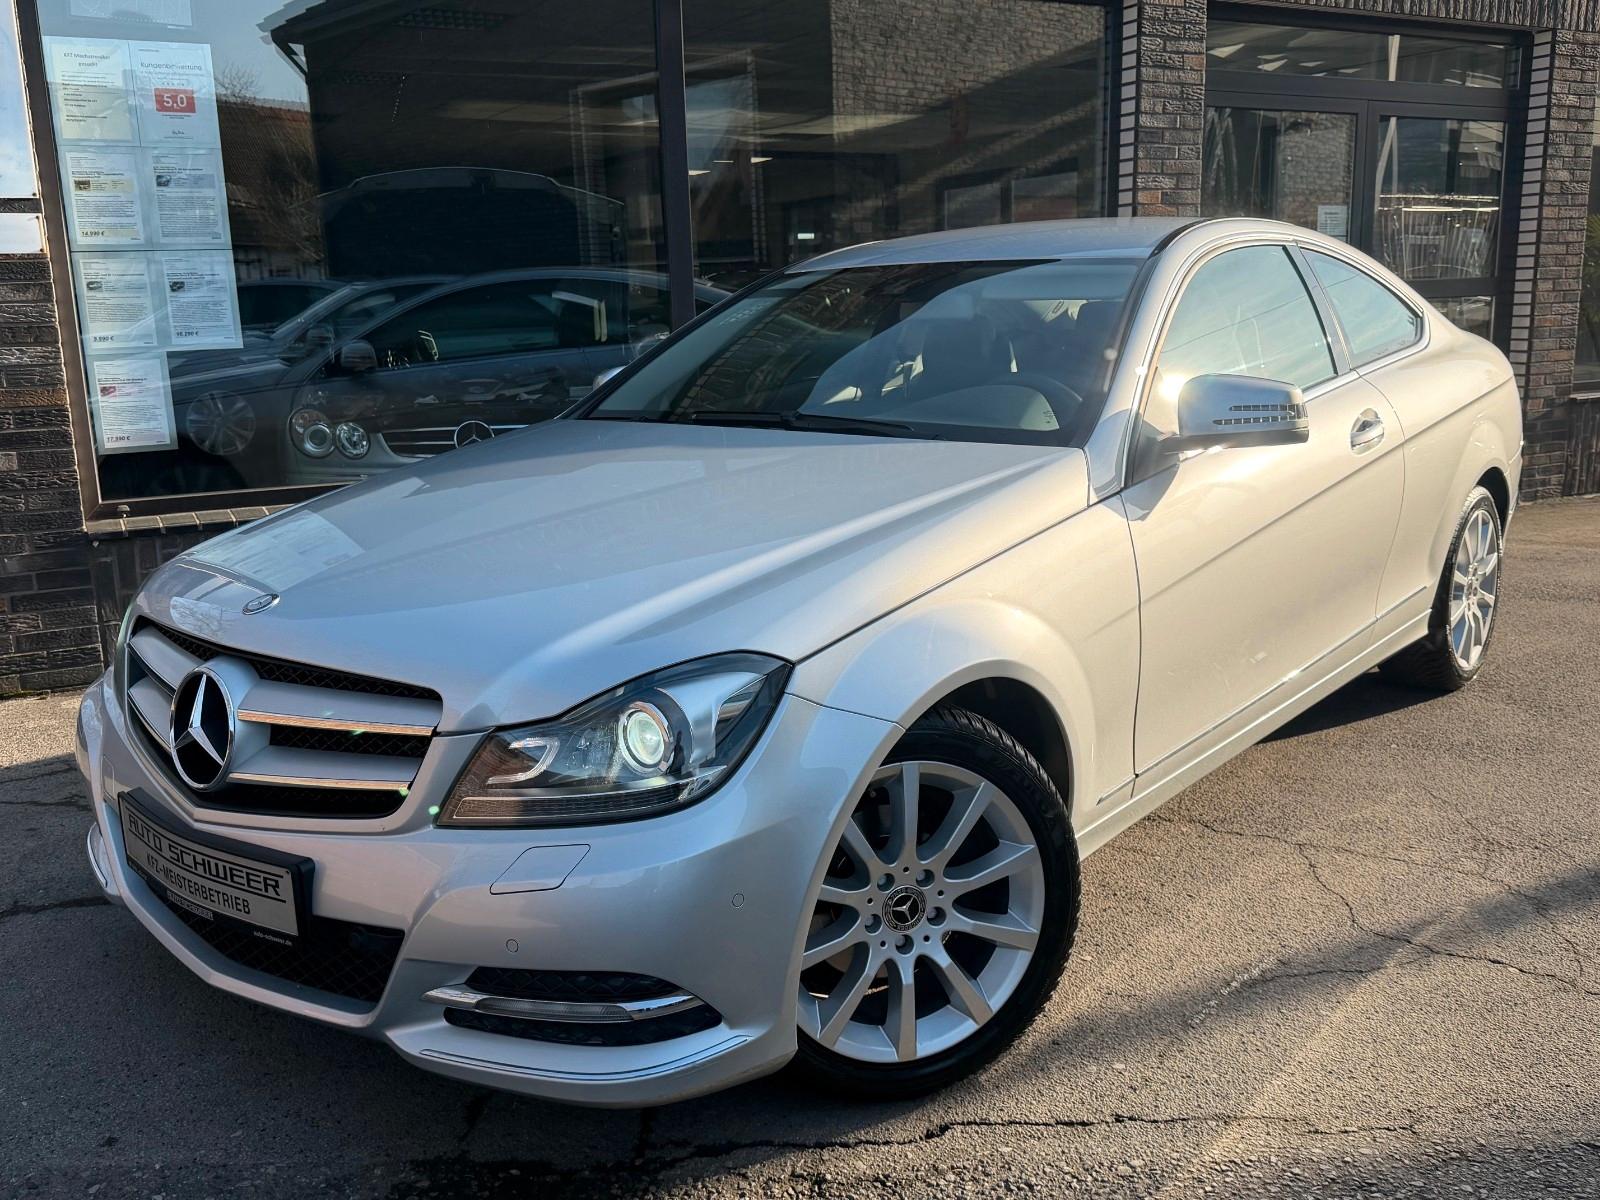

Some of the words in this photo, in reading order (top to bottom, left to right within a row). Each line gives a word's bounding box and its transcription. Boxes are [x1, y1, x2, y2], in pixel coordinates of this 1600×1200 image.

[163, 94, 187, 109] 5,0
[128, 814, 163, 852] AUTO
[168, 843, 281, 897] SCHWEER
[146, 852, 251, 915] KFZ-MEISTERBETRIEB
